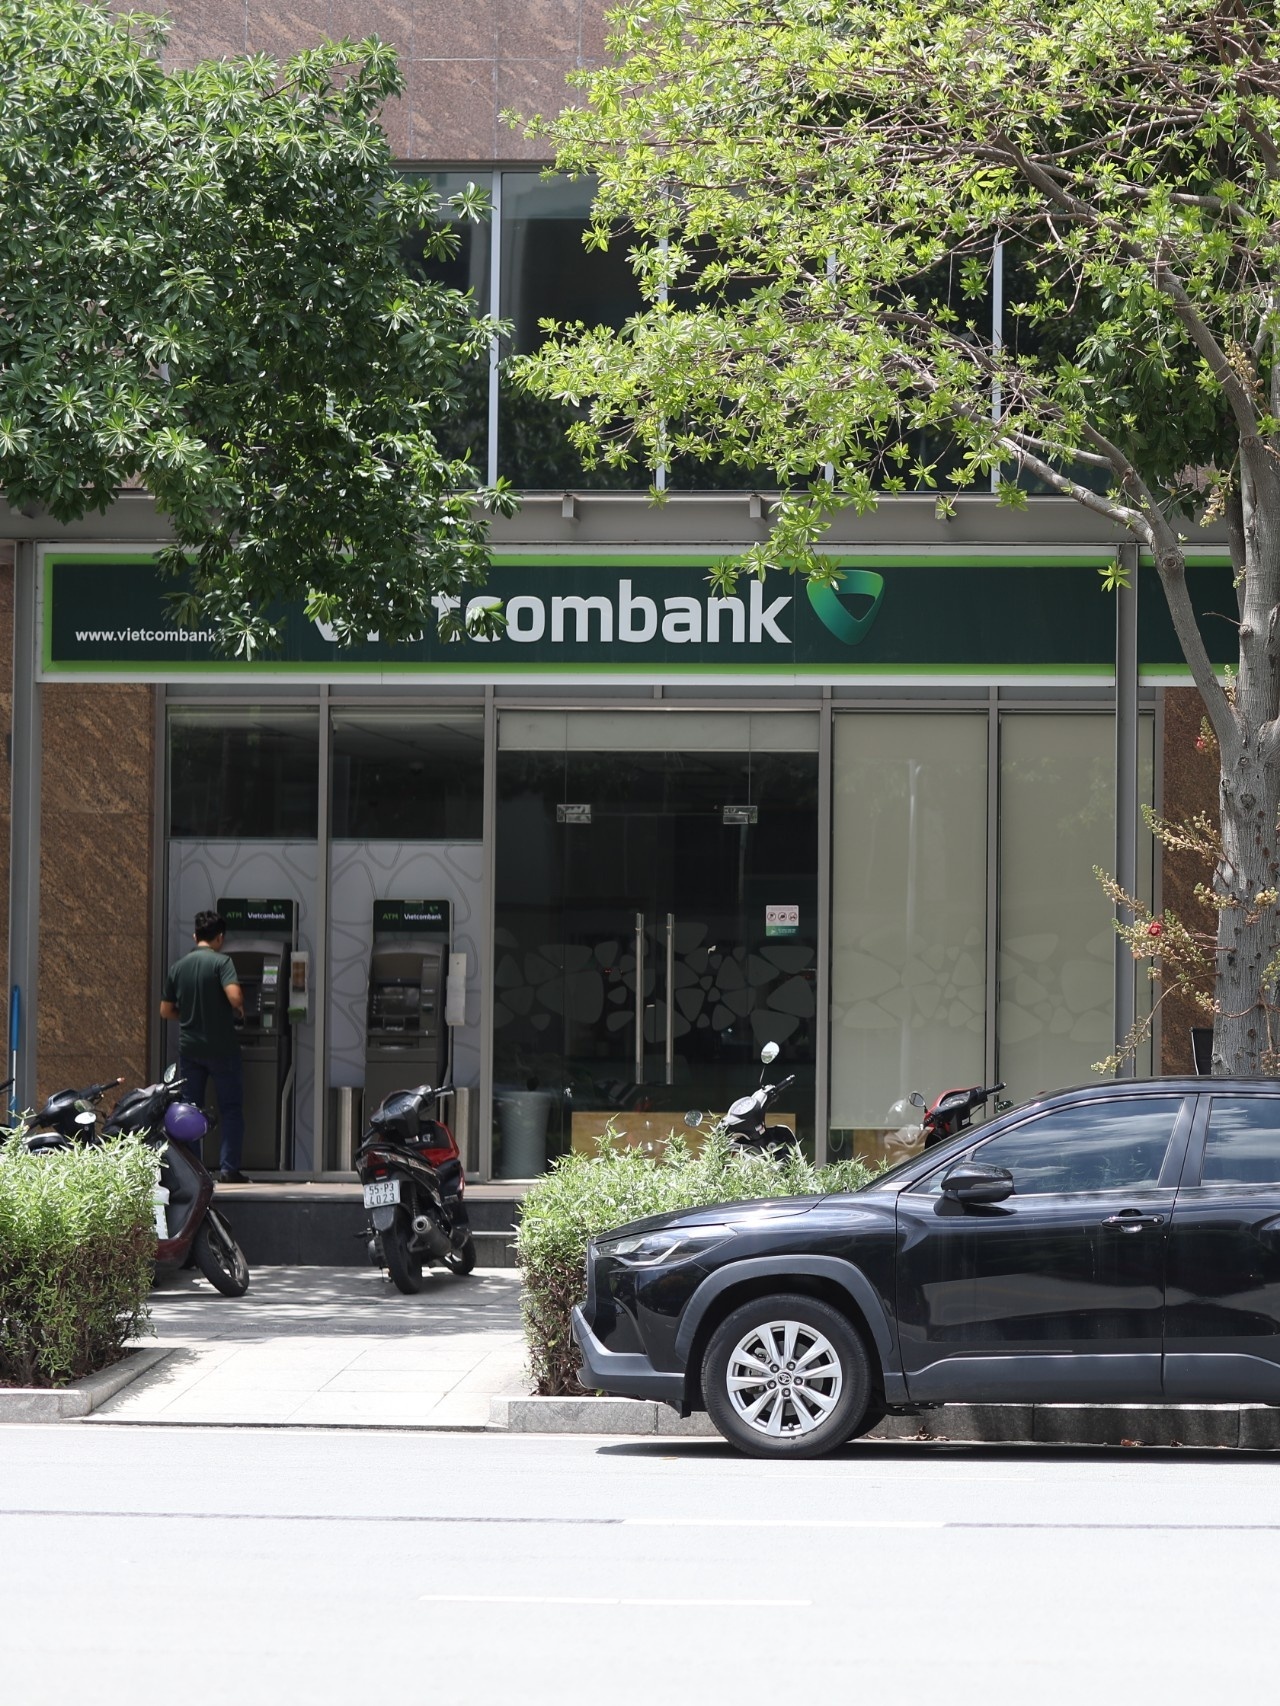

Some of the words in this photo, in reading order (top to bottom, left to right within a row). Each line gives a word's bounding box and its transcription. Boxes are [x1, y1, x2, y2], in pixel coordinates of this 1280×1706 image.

[308, 578, 792, 643] tcombank
[75, 628, 217, 642] www.vietcombank
[226, 911, 243, 919] ATM
[247, 911, 286, 920] Vietcombank
[382, 912, 399, 920] ATM
[403, 912, 442, 921] Vietcombank
